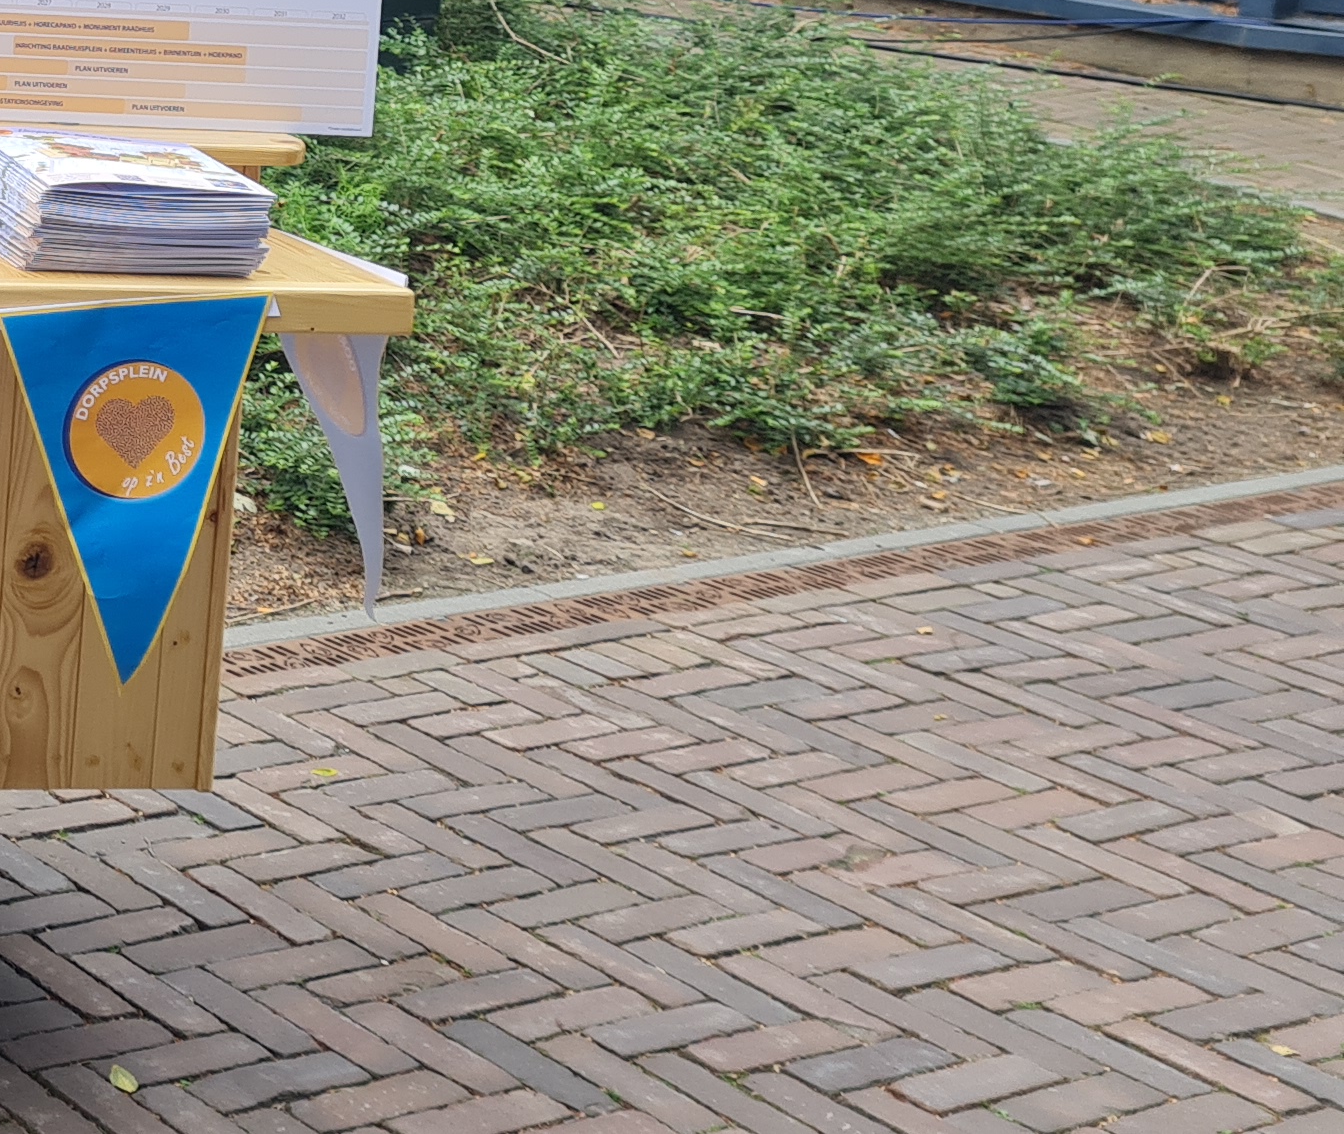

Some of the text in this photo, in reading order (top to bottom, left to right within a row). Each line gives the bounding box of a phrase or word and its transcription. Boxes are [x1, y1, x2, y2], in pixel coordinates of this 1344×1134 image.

[32, 81, 67, 89] UITVOEREN
[93, 66, 128, 74] UITVOEREN
[75, 365, 168, 422] DORPSPLEIN
[121, 474, 138, 496] op
[165, 435, 196, 476] Best
